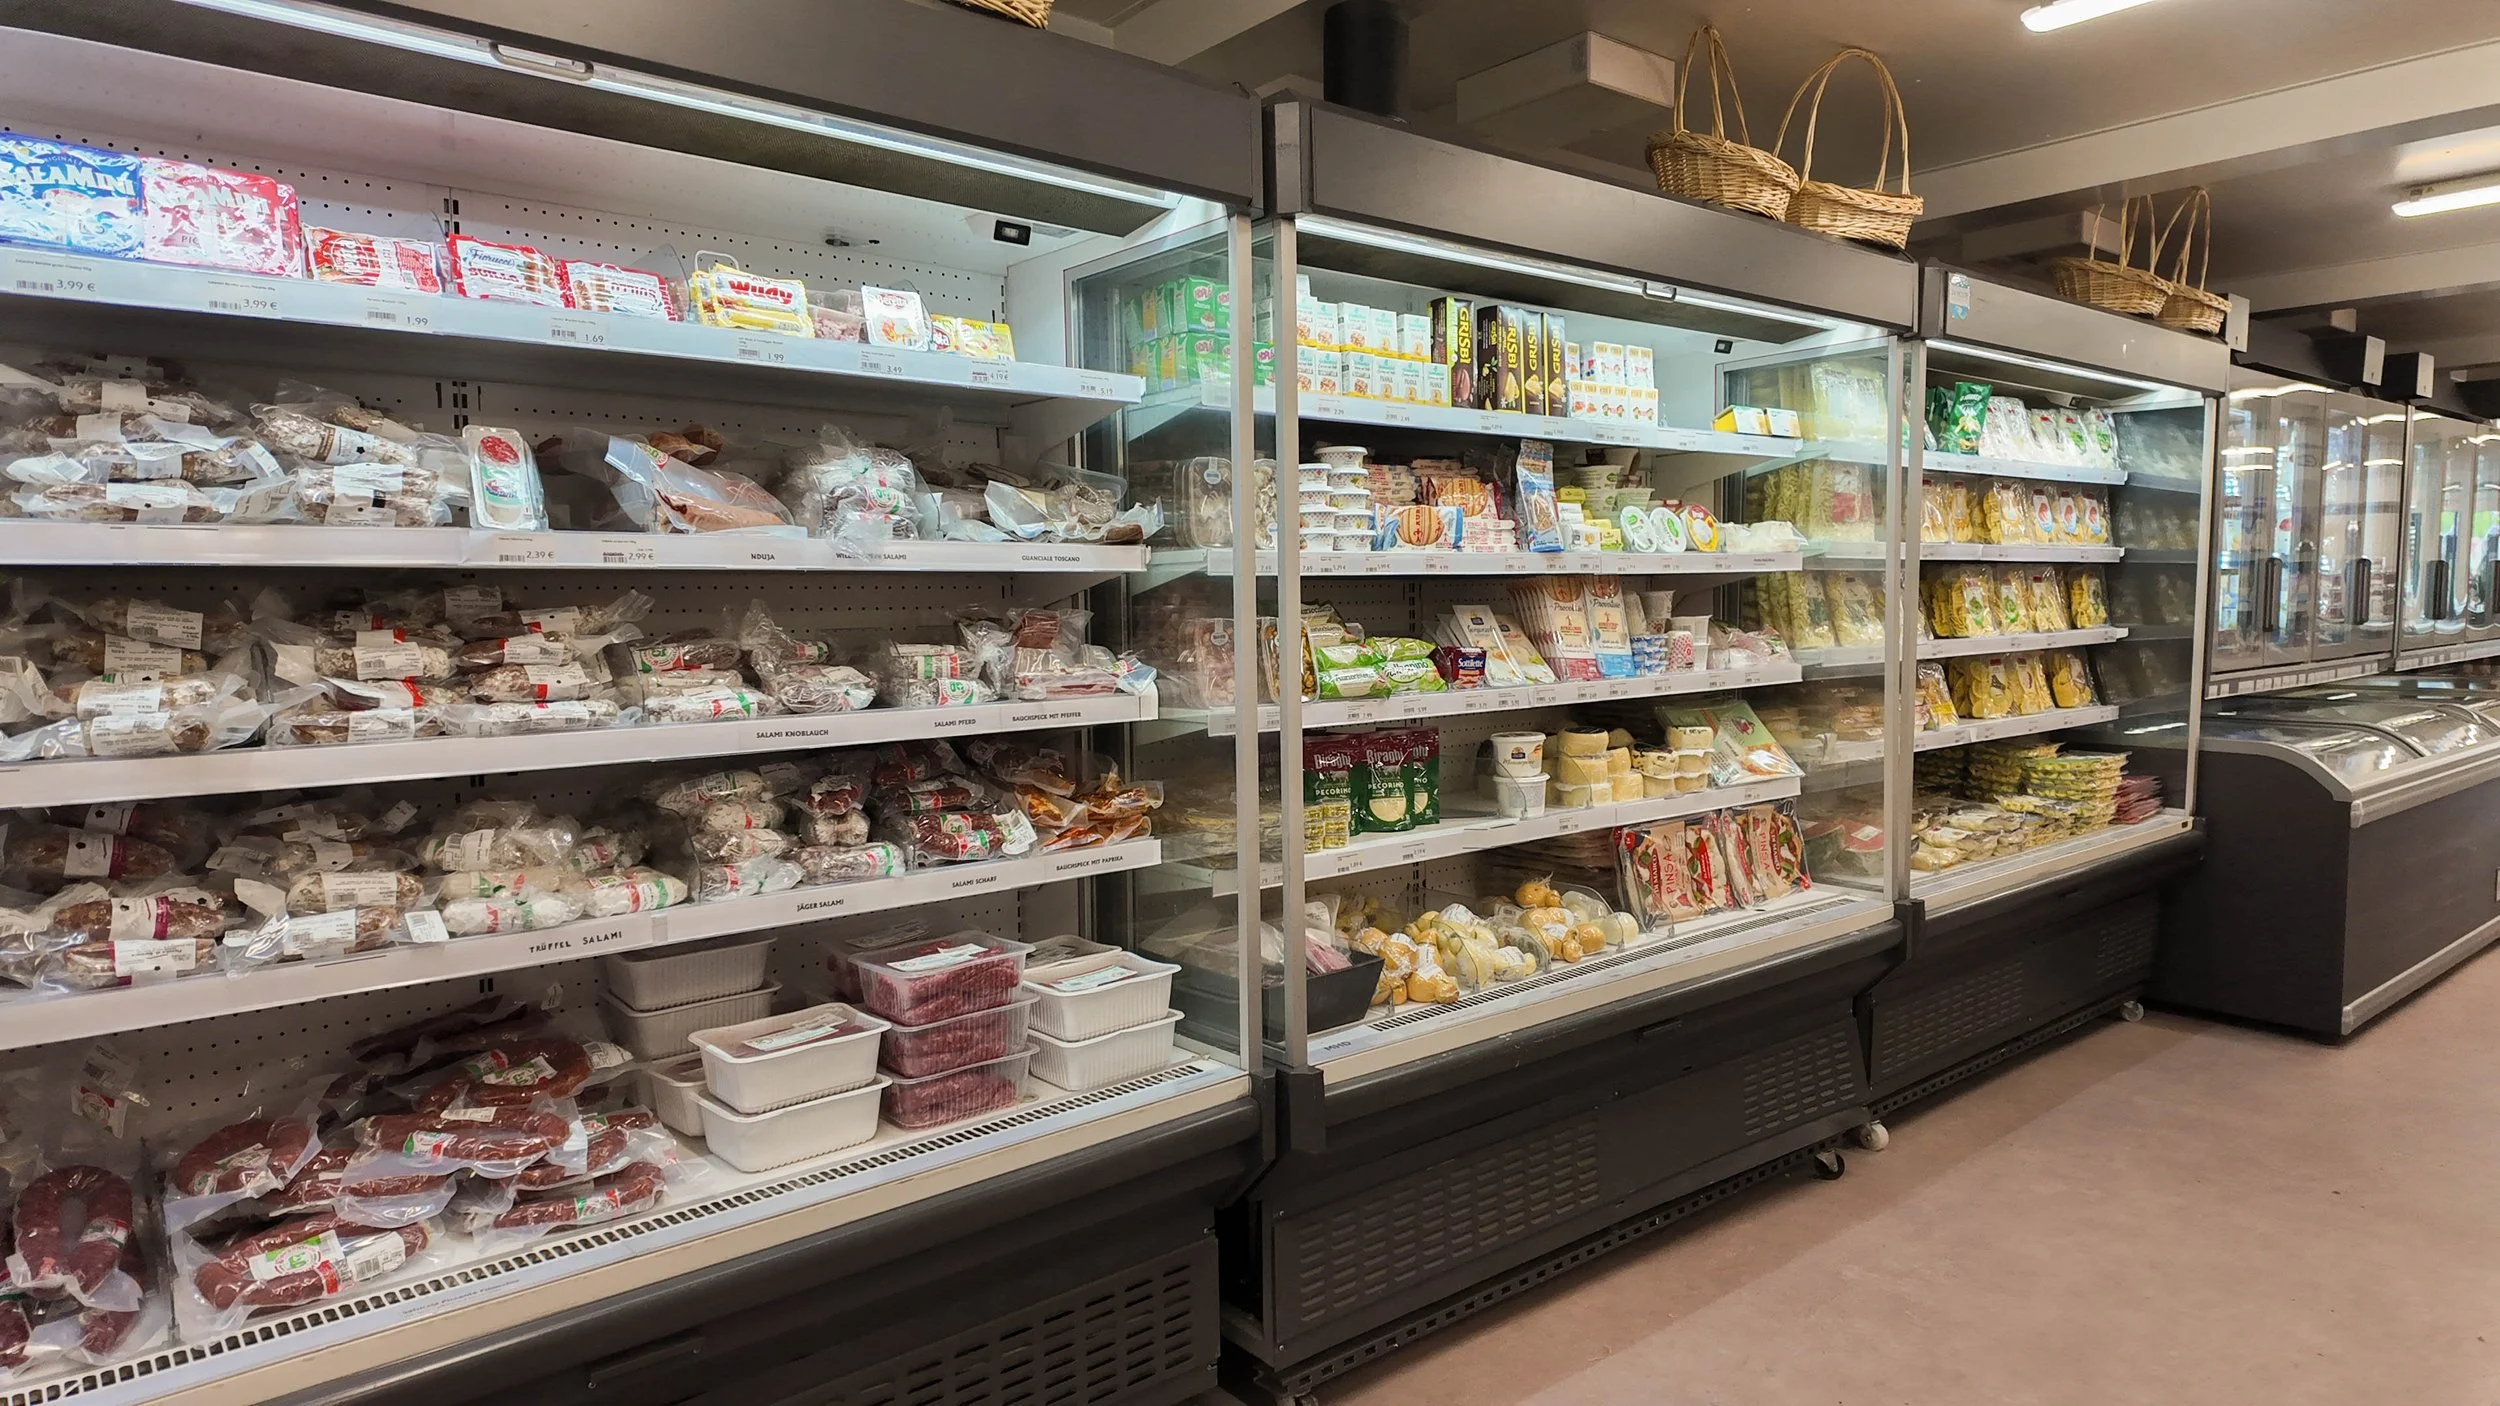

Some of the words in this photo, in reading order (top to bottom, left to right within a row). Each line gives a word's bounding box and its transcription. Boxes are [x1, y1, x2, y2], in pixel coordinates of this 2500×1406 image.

[87, 282, 96, 292] €
[728, 280, 793, 305] Wudy
[270, 301, 278, 310] €
[751, 553, 776, 561] NDUJA
[1012, 714, 1048, 722] BAUCHSPECK
[1059, 712, 1082, 720] PFEFFER
[934, 719, 957, 728] SALAMI
[958, 718, 977, 726] PFERD
[756, 731, 783, 739] SALAMI
[784, 729, 829, 737] KNOBLAUCH
[1368, 781, 1405, 790] PECORINO
[1056, 860, 1091, 871] BAUCHSPECK
[1091, 859, 1101, 867] MIT
[1101, 855, 1124, 864] PAPRIKA
[1663, 853, 1674, 894] PINSA
[952, 878, 974, 888] SALAMI
[975, 876, 997, 886] SCHARF
[797, 901, 818, 912] JÄGER
[819, 899, 844, 909] SALAMI
[529, 941, 572, 953] TRÜFFEL
[583, 931, 622, 945] SALAMI
